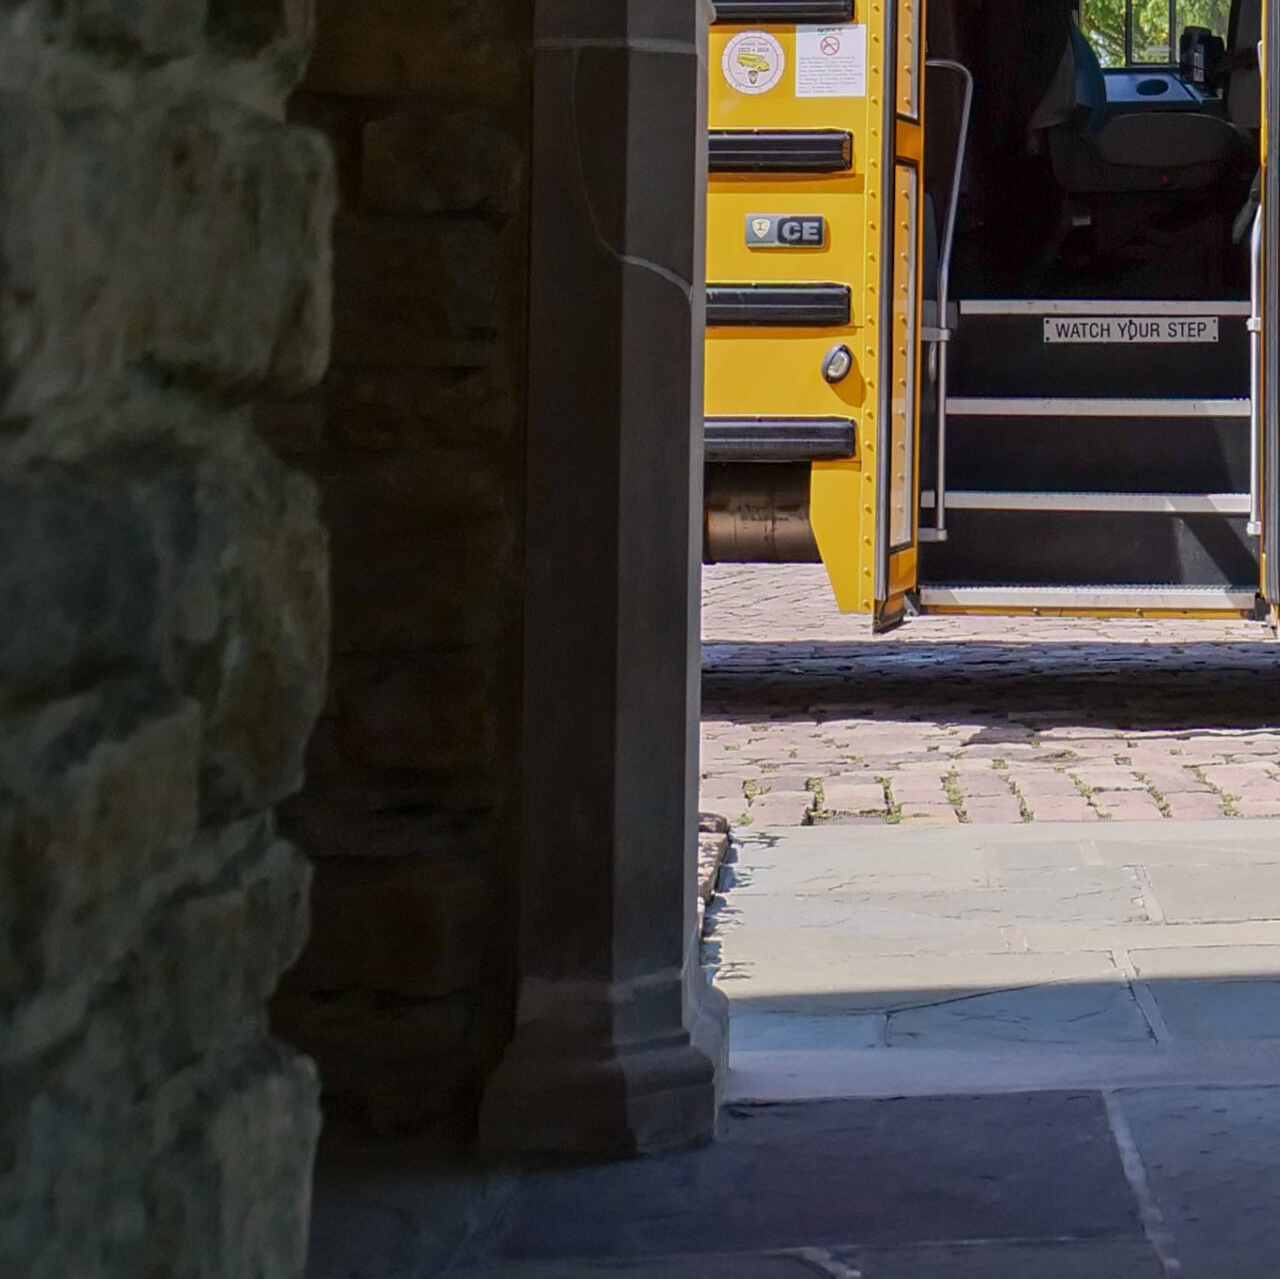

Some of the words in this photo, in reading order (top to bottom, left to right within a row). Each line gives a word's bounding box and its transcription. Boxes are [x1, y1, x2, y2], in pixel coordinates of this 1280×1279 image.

[782, 221, 819, 241] CE
[1056, 323, 1110, 338] WATCH
[1118, 323, 1160, 338] YOUR
[1168, 322, 1207, 338] STEP
